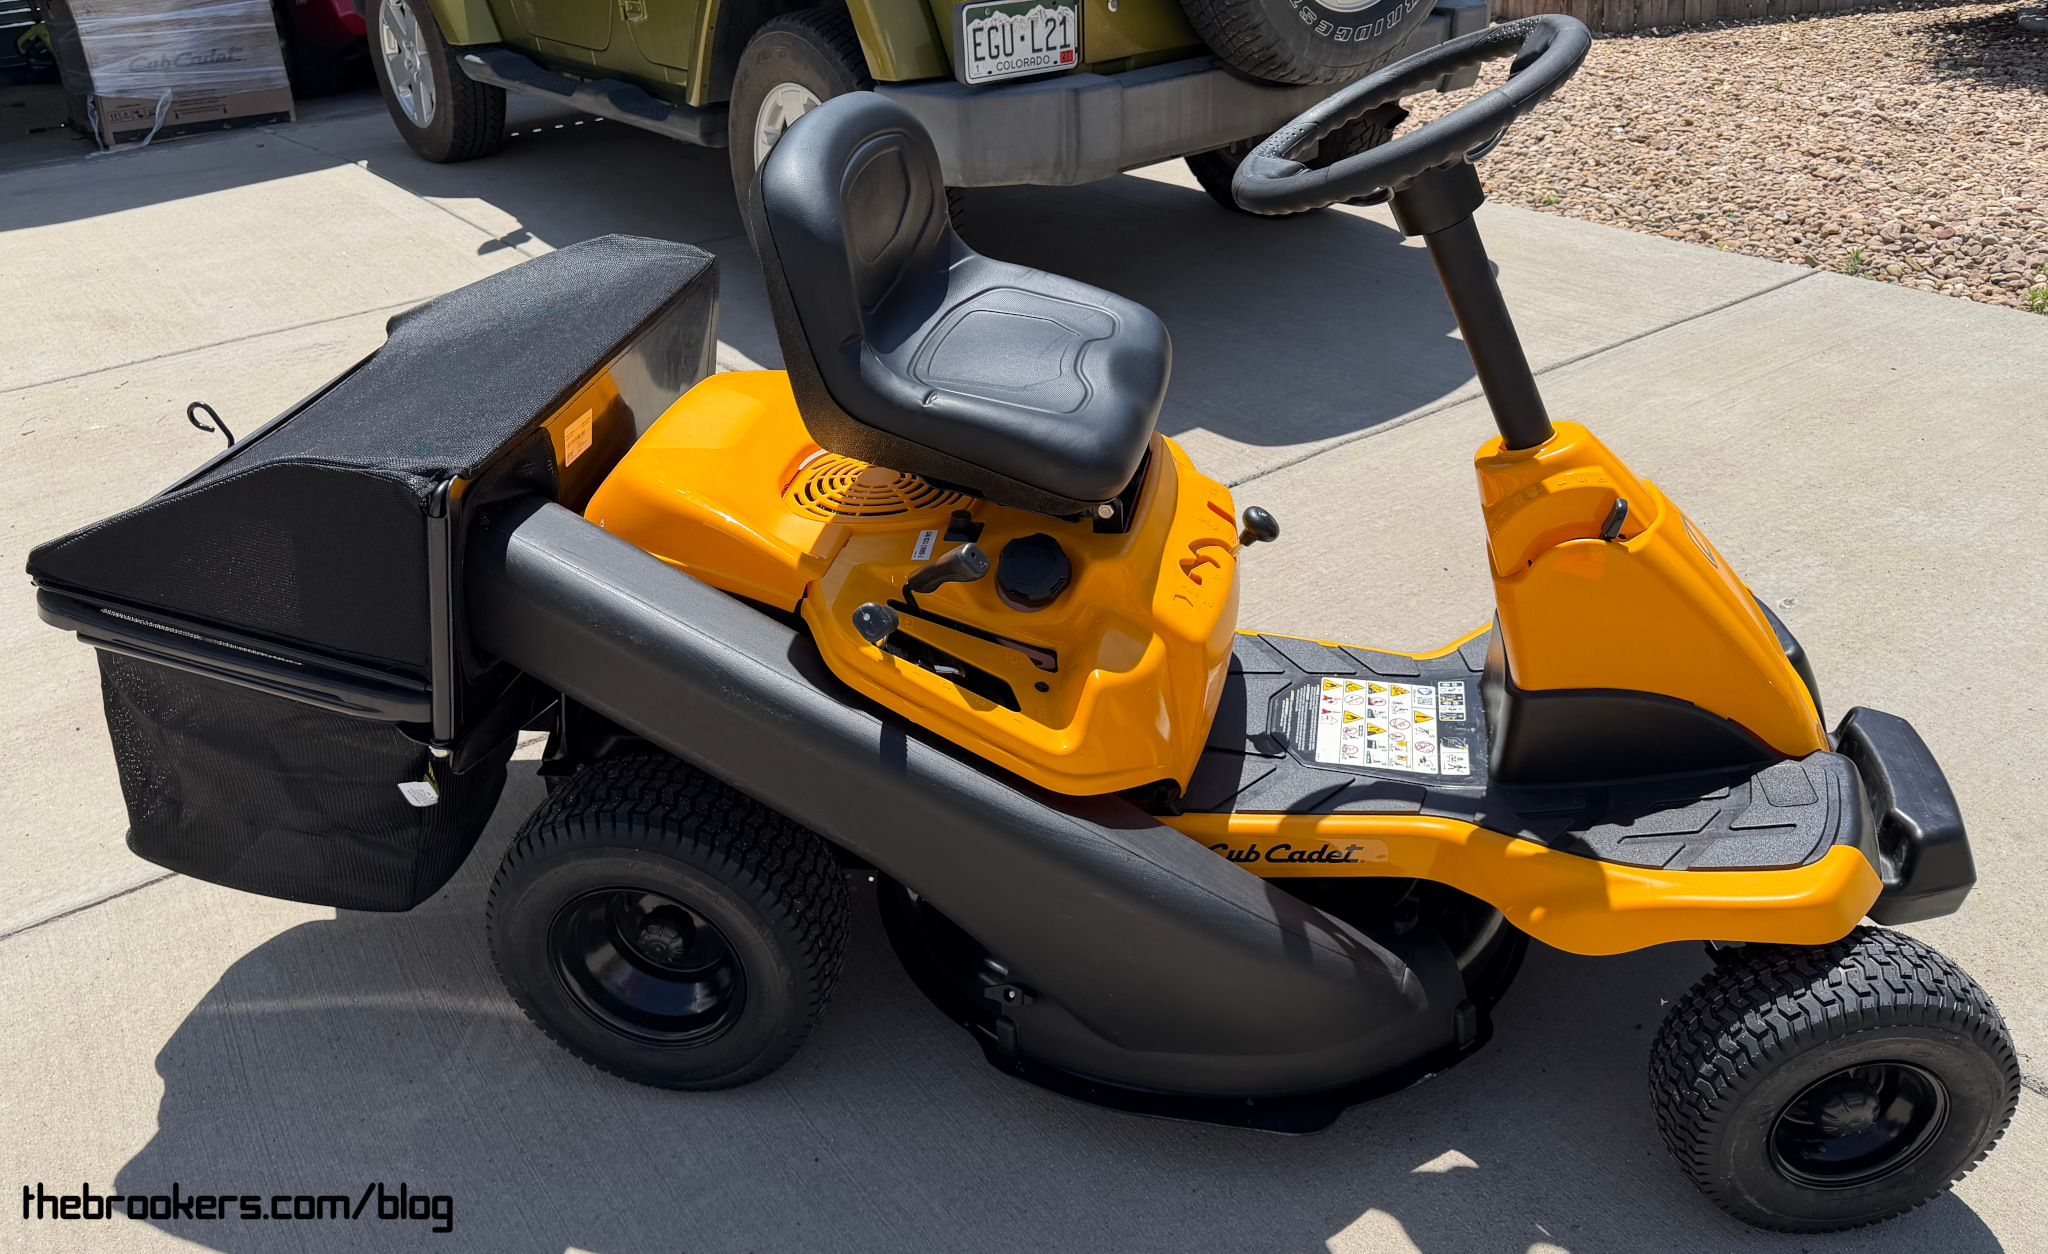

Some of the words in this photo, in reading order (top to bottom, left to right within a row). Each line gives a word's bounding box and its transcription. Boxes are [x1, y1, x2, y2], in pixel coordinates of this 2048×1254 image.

[128, 54, 173, 72] Cub
[996, 55, 1051, 72] COLORADO
[1061, 50, 1071, 60] 27
[1264, 844, 1364, 863] Cadet
